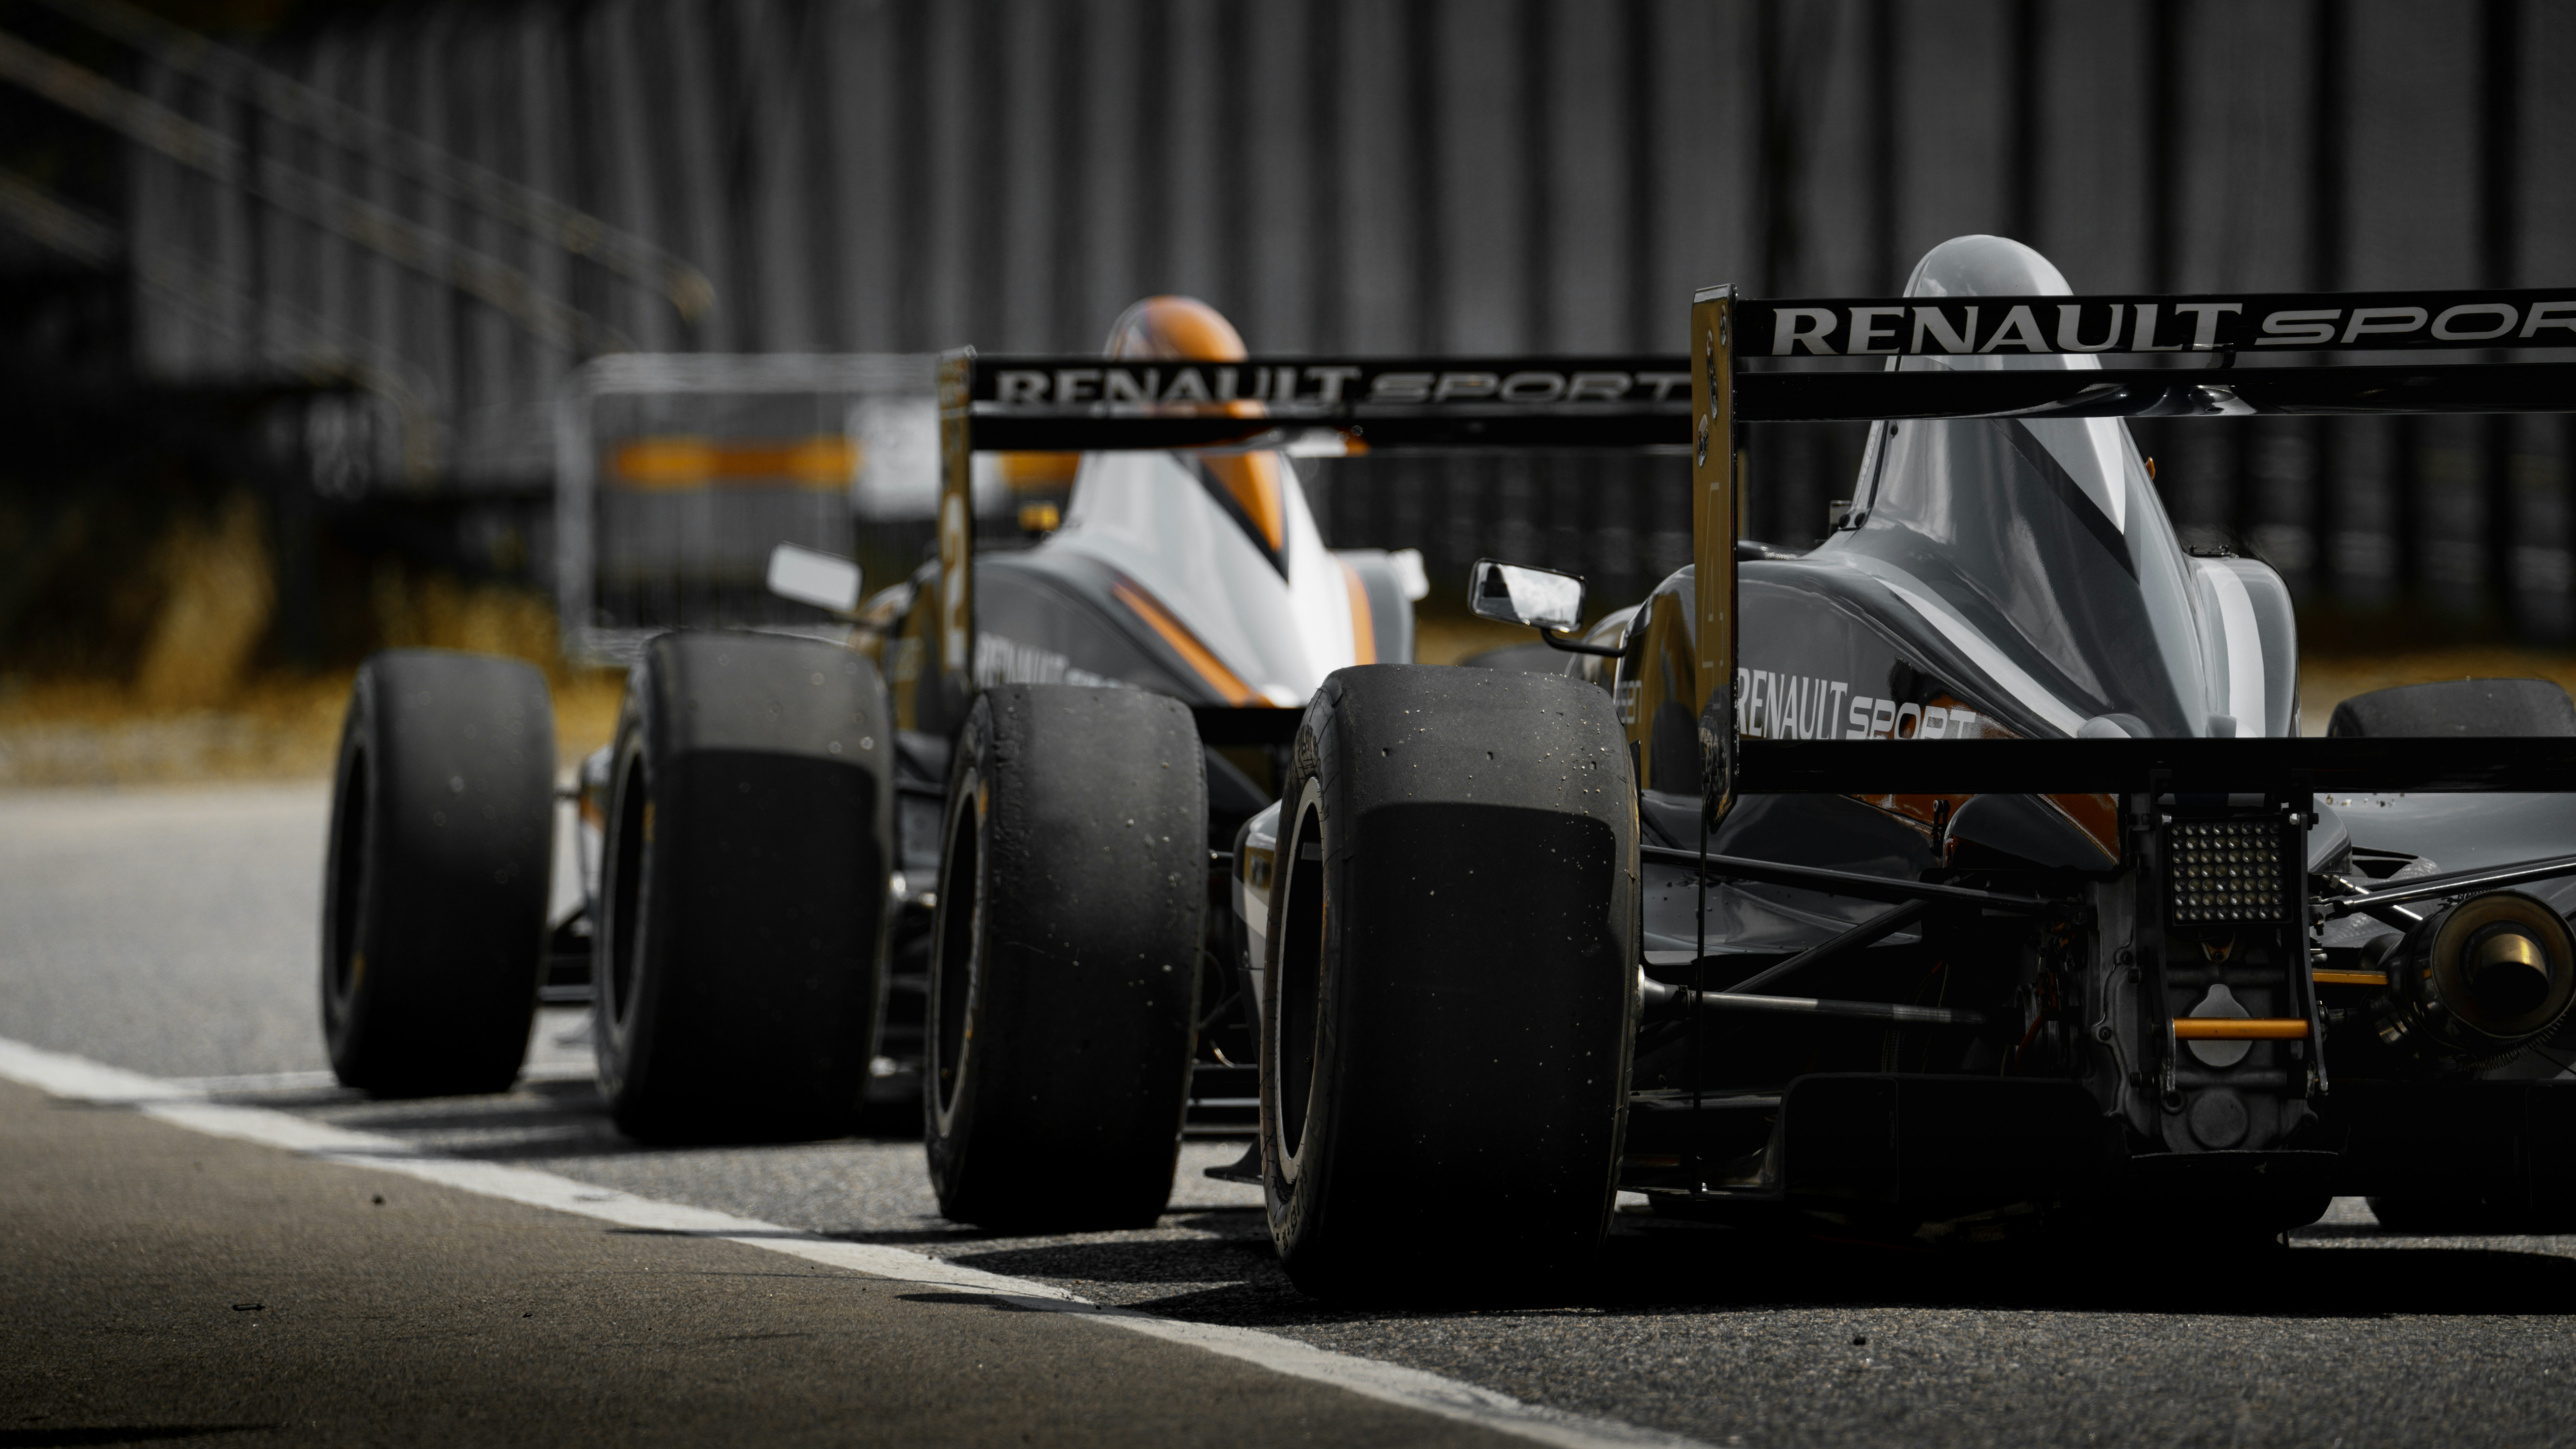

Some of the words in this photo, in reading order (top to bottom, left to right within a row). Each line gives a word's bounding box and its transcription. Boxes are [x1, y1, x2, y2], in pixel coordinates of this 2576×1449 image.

[1772, 303, 2243, 355] RENAULT
[2254, 301, 2576, 345] SPOR
[993, 364, 1363, 404] RENAULT
[1365, 370, 1692, 403] SPORT
[1737, 667, 1849, 740] RENAULT
